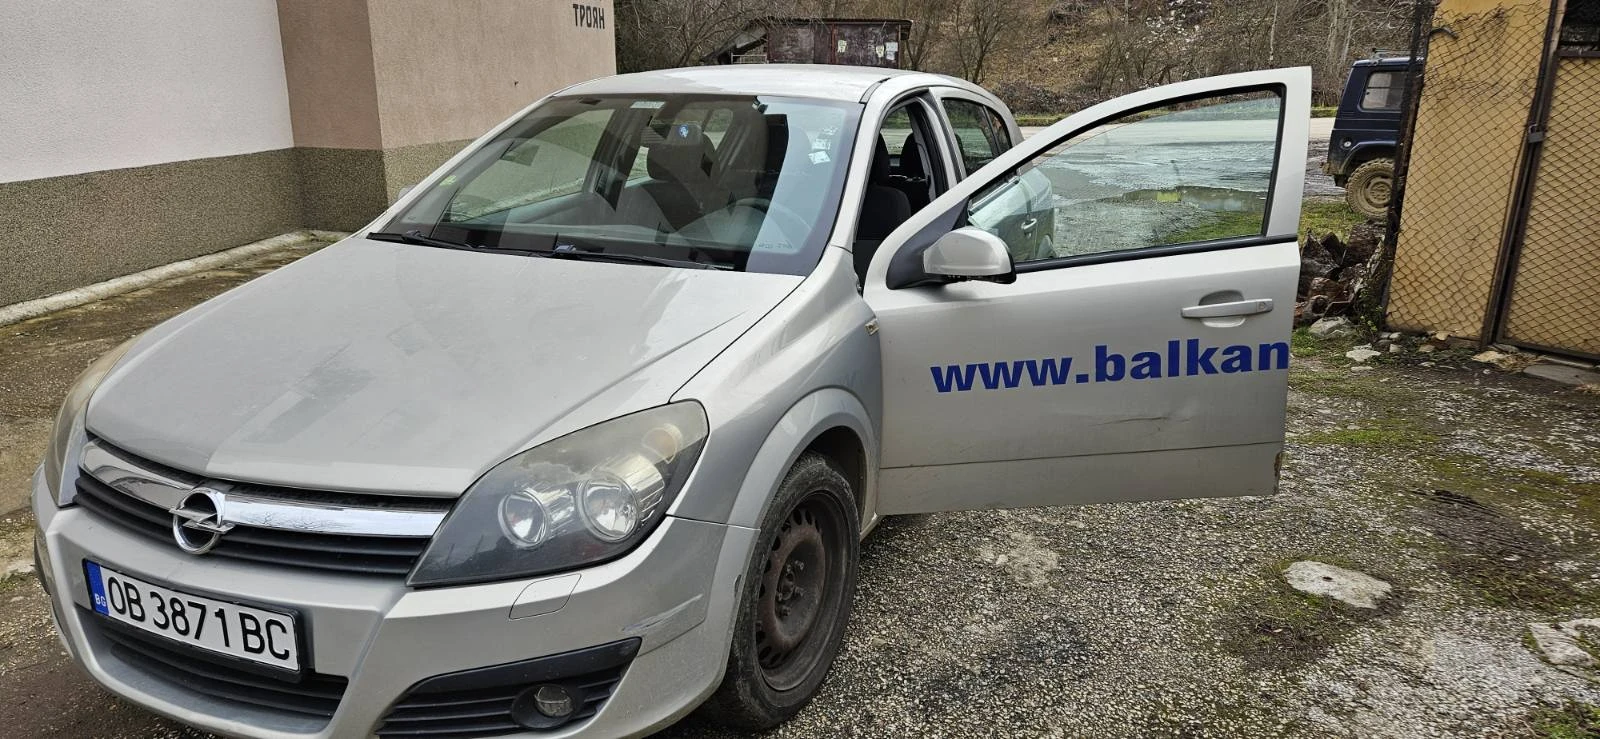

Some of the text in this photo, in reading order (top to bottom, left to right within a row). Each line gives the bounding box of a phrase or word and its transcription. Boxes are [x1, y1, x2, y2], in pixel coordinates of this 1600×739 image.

[572, 4, 605, 29] ТРОЯН
[930, 338, 1289, 393] www.balkan
[94, 592, 107, 607] BG
[150, 591, 230, 648] 3871
[239, 612, 290, 660] BC
